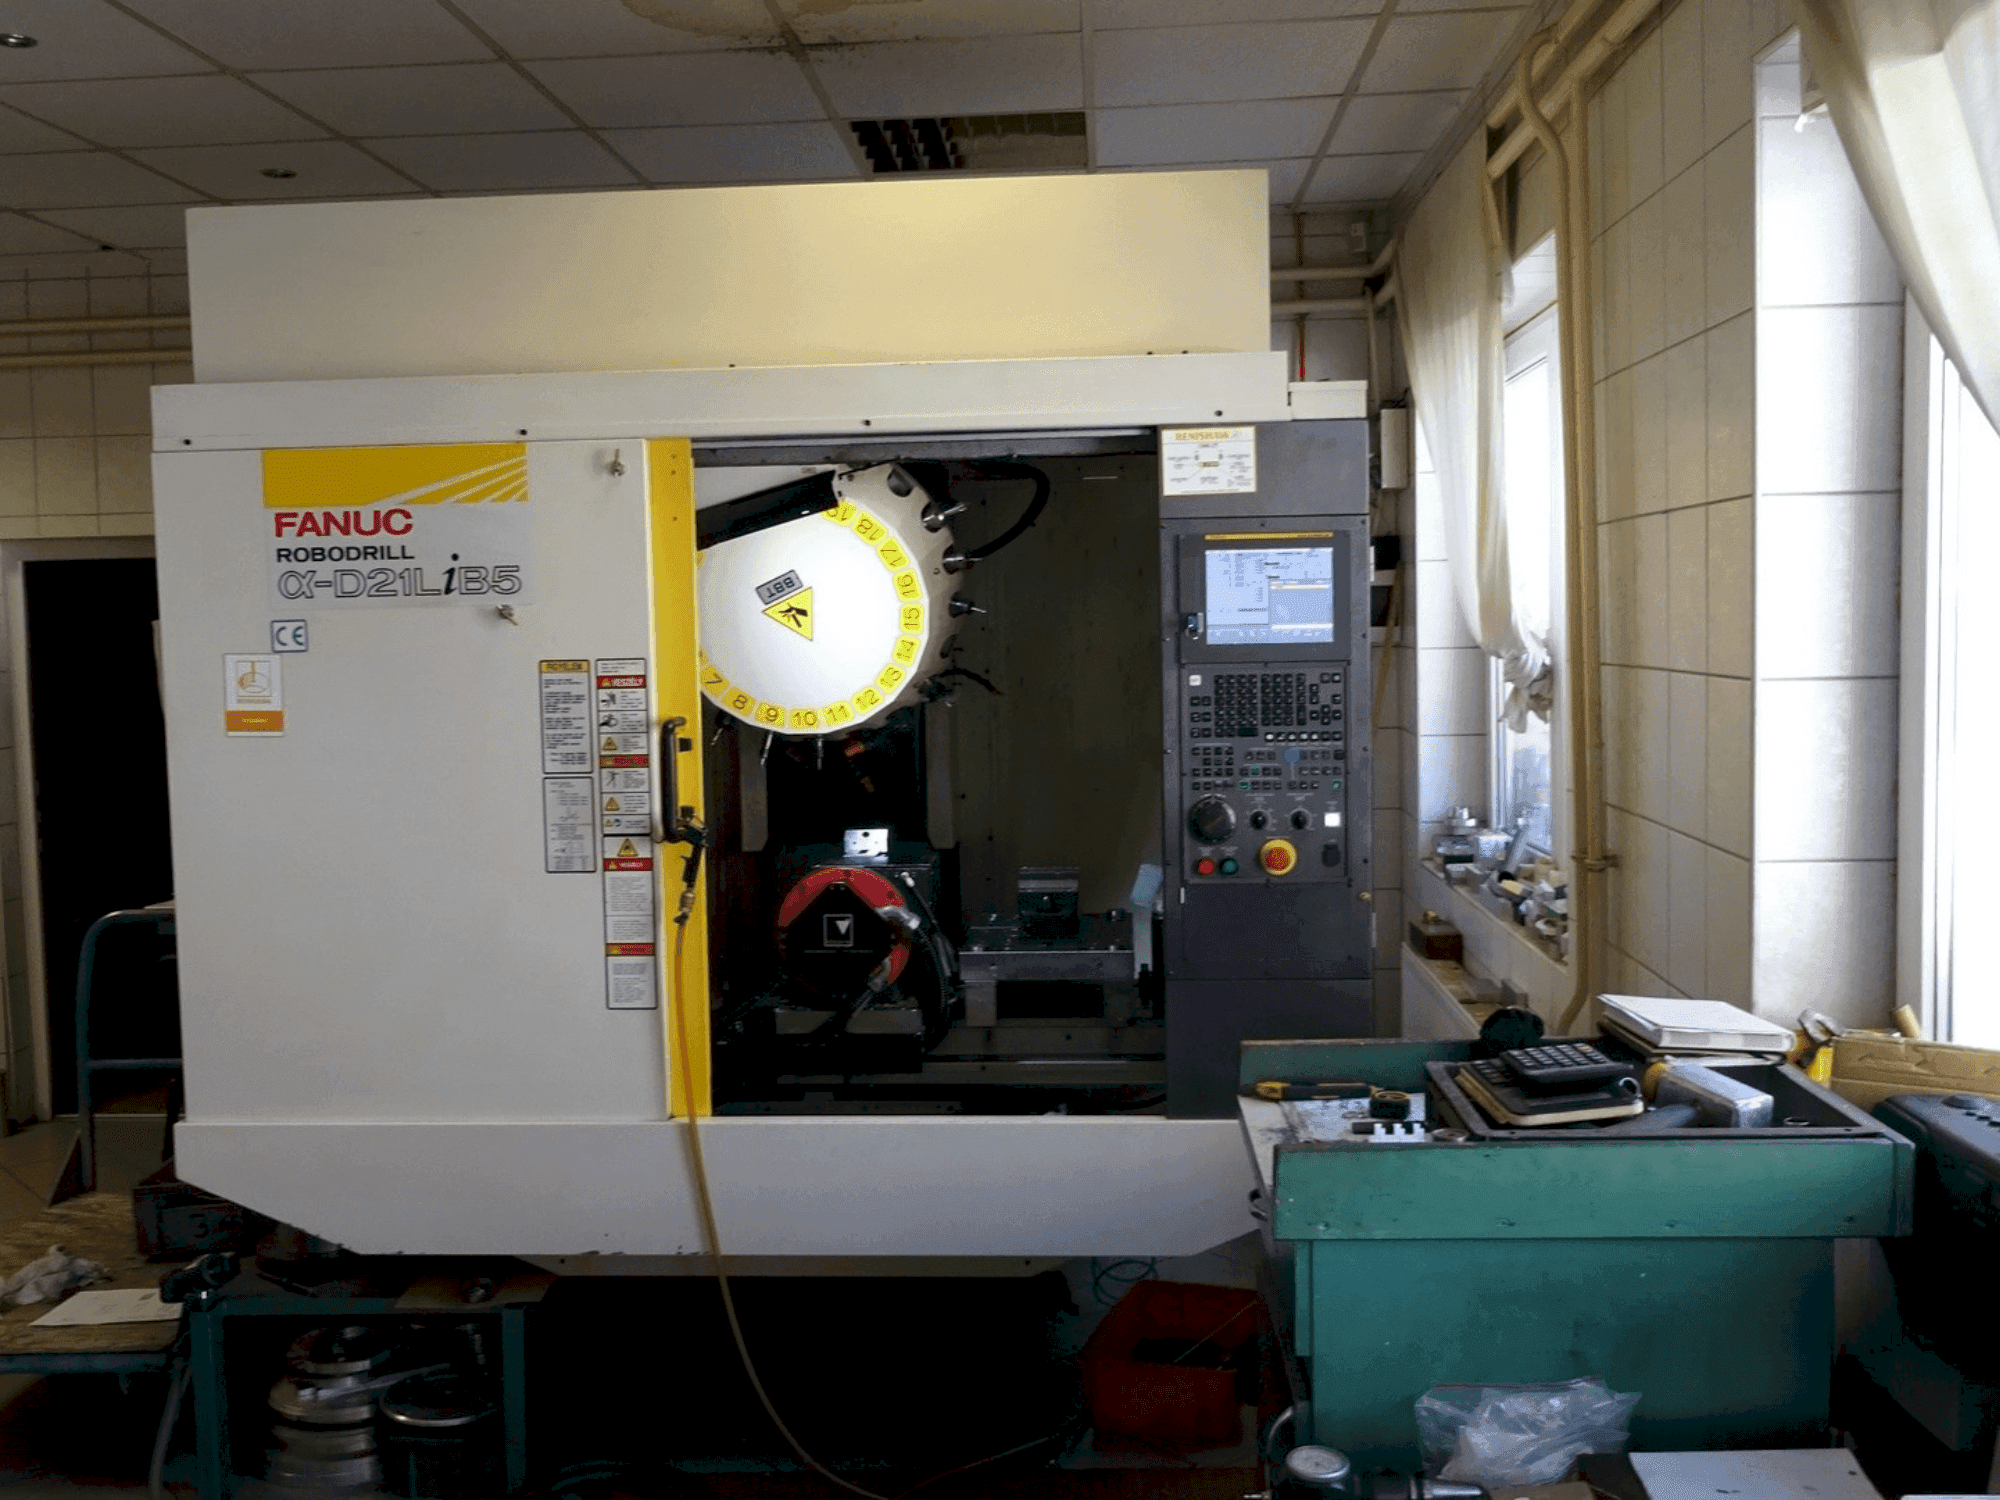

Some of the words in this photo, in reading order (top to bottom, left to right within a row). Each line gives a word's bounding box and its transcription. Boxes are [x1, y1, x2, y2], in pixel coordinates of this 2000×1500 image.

[274, 508, 414, 538] FANUC
[856, 518, 880, 541] 18
[276, 545, 416, 563] ROBODRILL
[879, 547, 903, 567] 17
[765, 576, 796, 599] BBT
[896, 574, 916, 597] 16
[902, 606, 920, 630] 15
[896, 639, 915, 659] 14
[704, 672, 724, 685] 7
[879, 667, 903, 688] 13
[731, 693, 749, 710] 8
[856, 689, 881, 708] 12
[764, 707, 779, 722] 9
[792, 711, 818, 726] 10
[826, 704, 849, 722] 11
